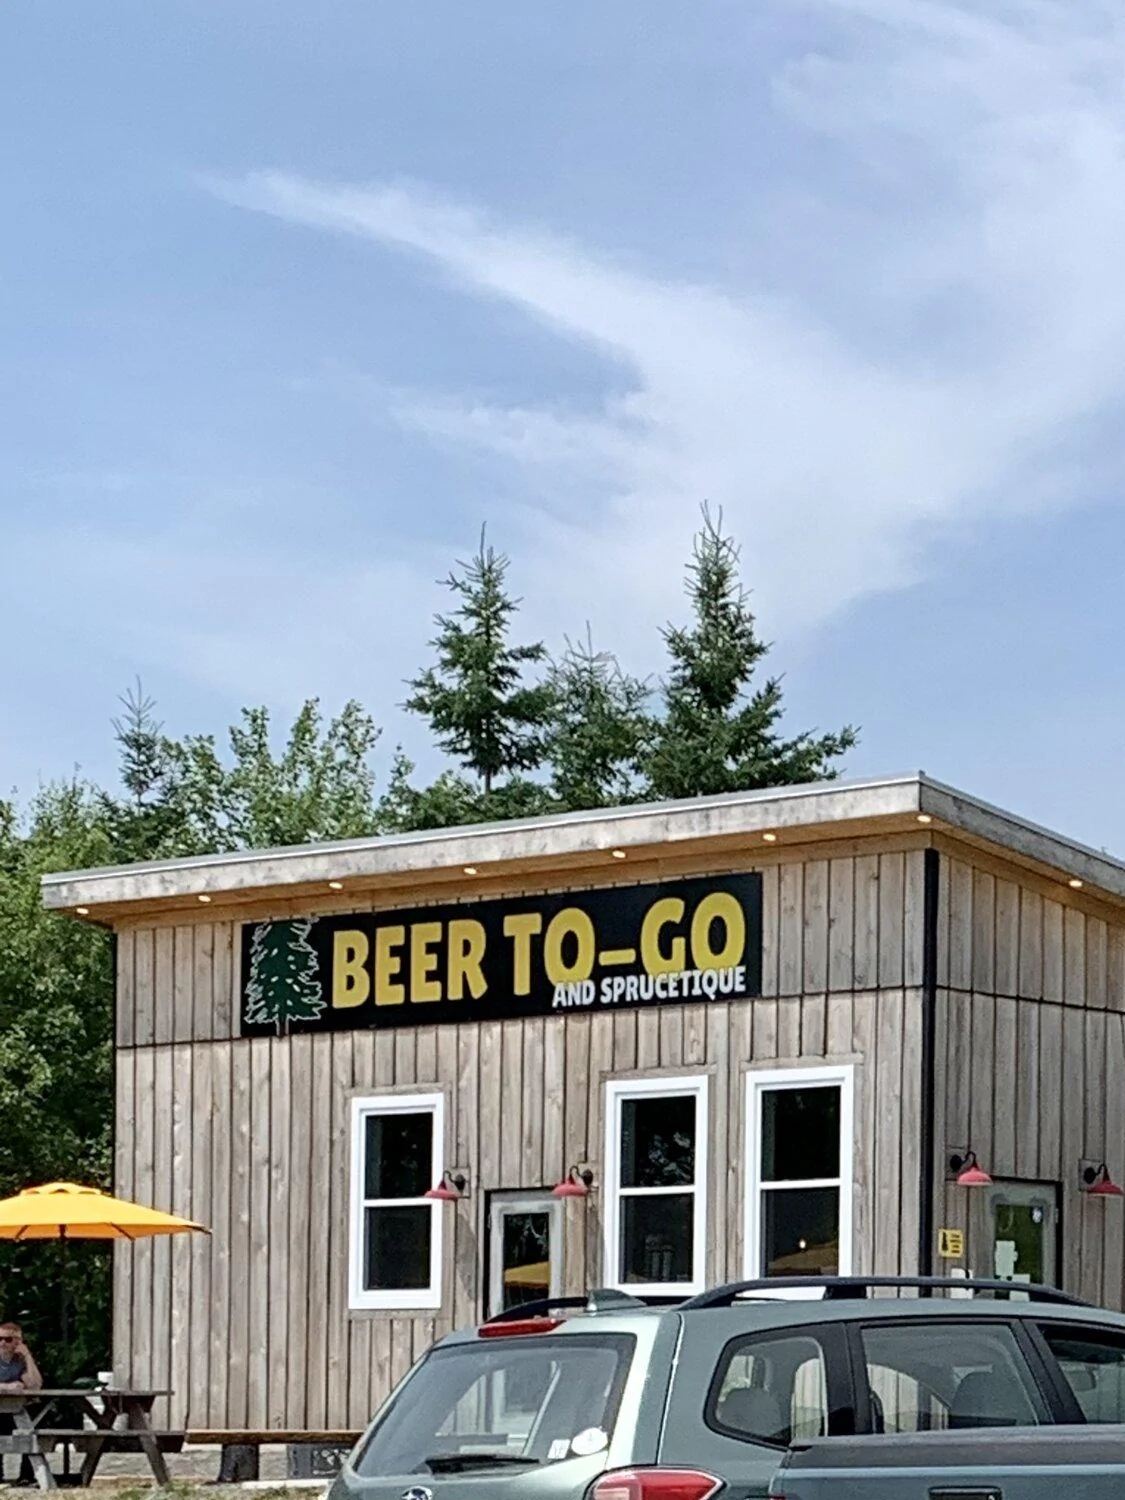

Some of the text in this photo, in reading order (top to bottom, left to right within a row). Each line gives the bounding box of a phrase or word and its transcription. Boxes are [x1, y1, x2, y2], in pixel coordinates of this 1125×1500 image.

[332, 892, 746, 1009] BEER TO-GO
[552, 966, 746, 1008] AND SPRUCETIQUE
